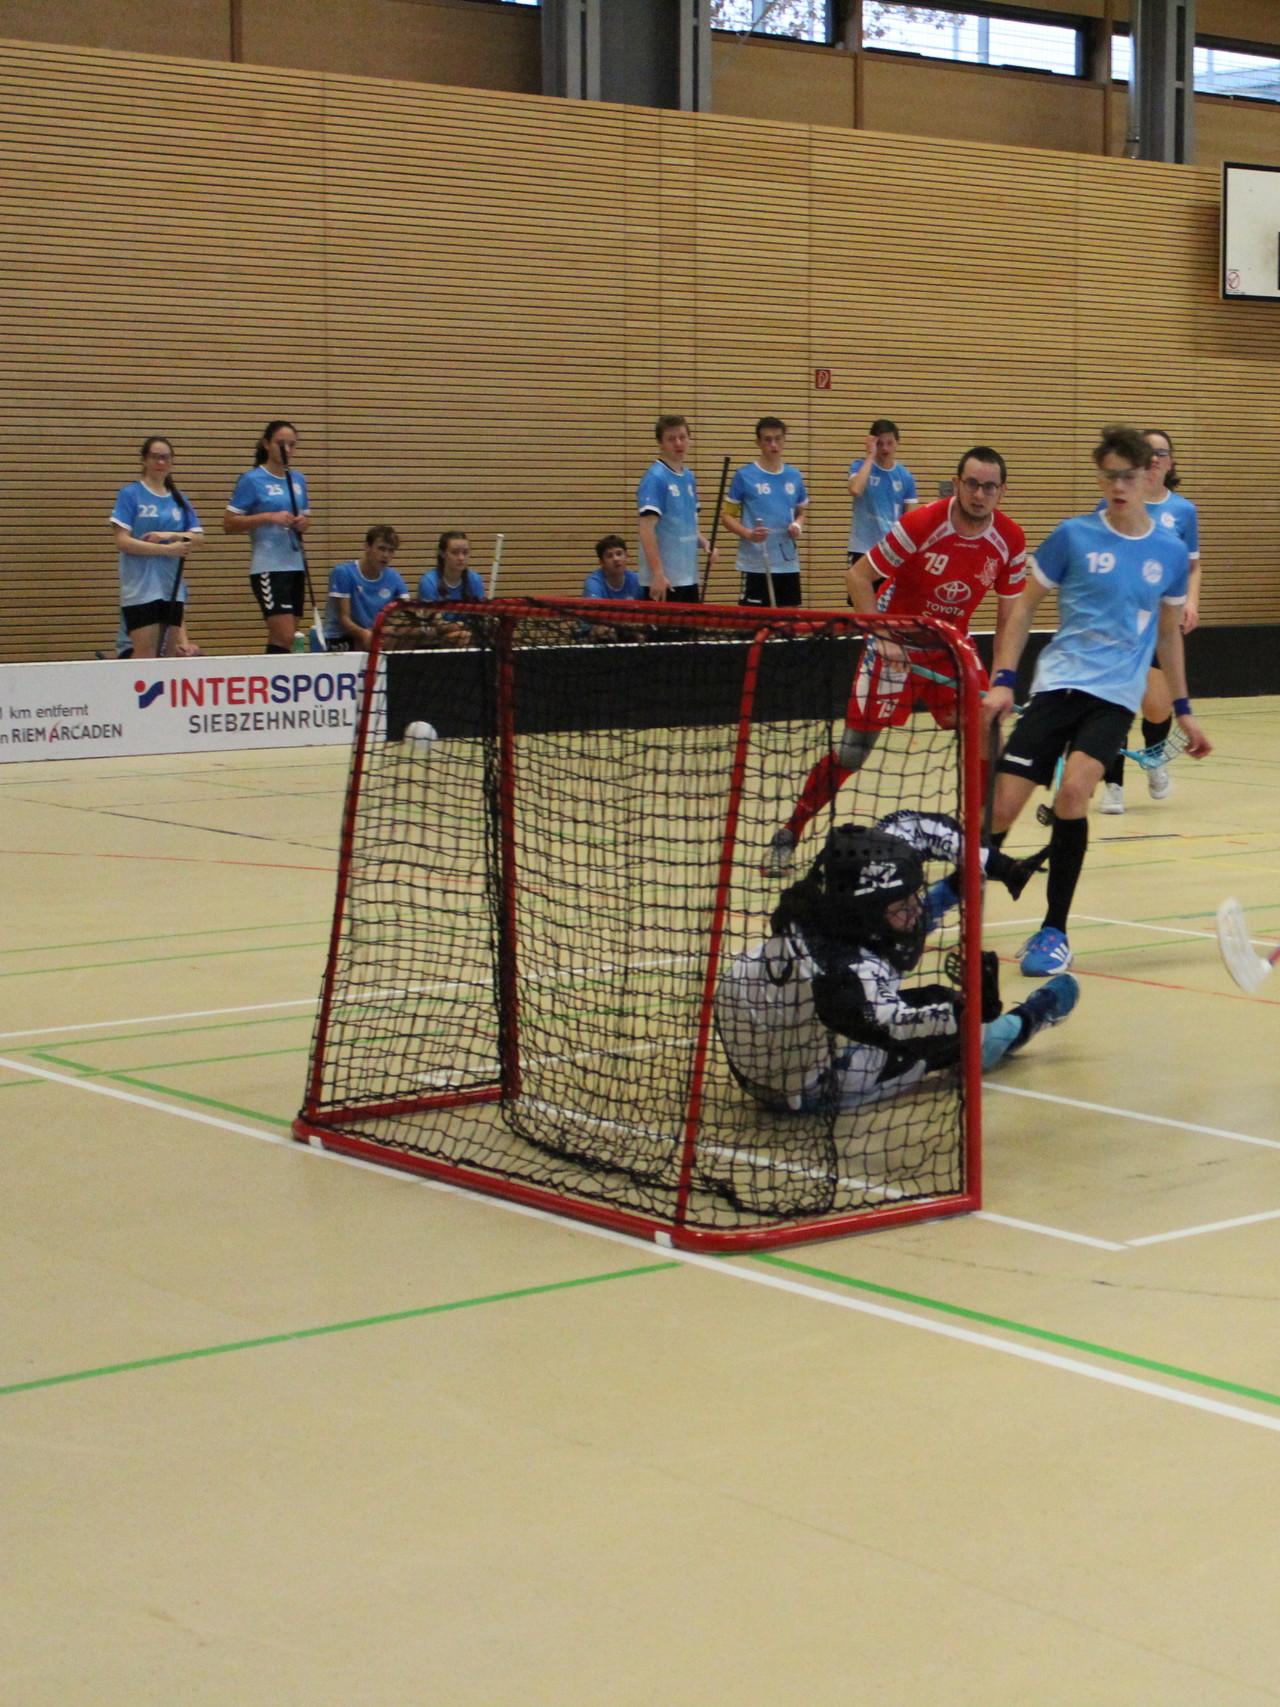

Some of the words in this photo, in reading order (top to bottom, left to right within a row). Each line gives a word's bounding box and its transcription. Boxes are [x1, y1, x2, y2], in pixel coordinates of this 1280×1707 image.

[265, 484, 283, 496] 25
[755, 483, 771, 495] 16
[138, 505, 159, 518] 22
[923, 552, 949, 576] 79
[1086, 552, 1116, 573] 19
[926, 601, 965, 617] TOYOTA
[10, 706, 31, 719] km
[36, 704, 89, 719] entfernt
[189, 704, 353, 734] SIEBZEHNRÜBL
[49, 722, 123, 744] ARCADEN
